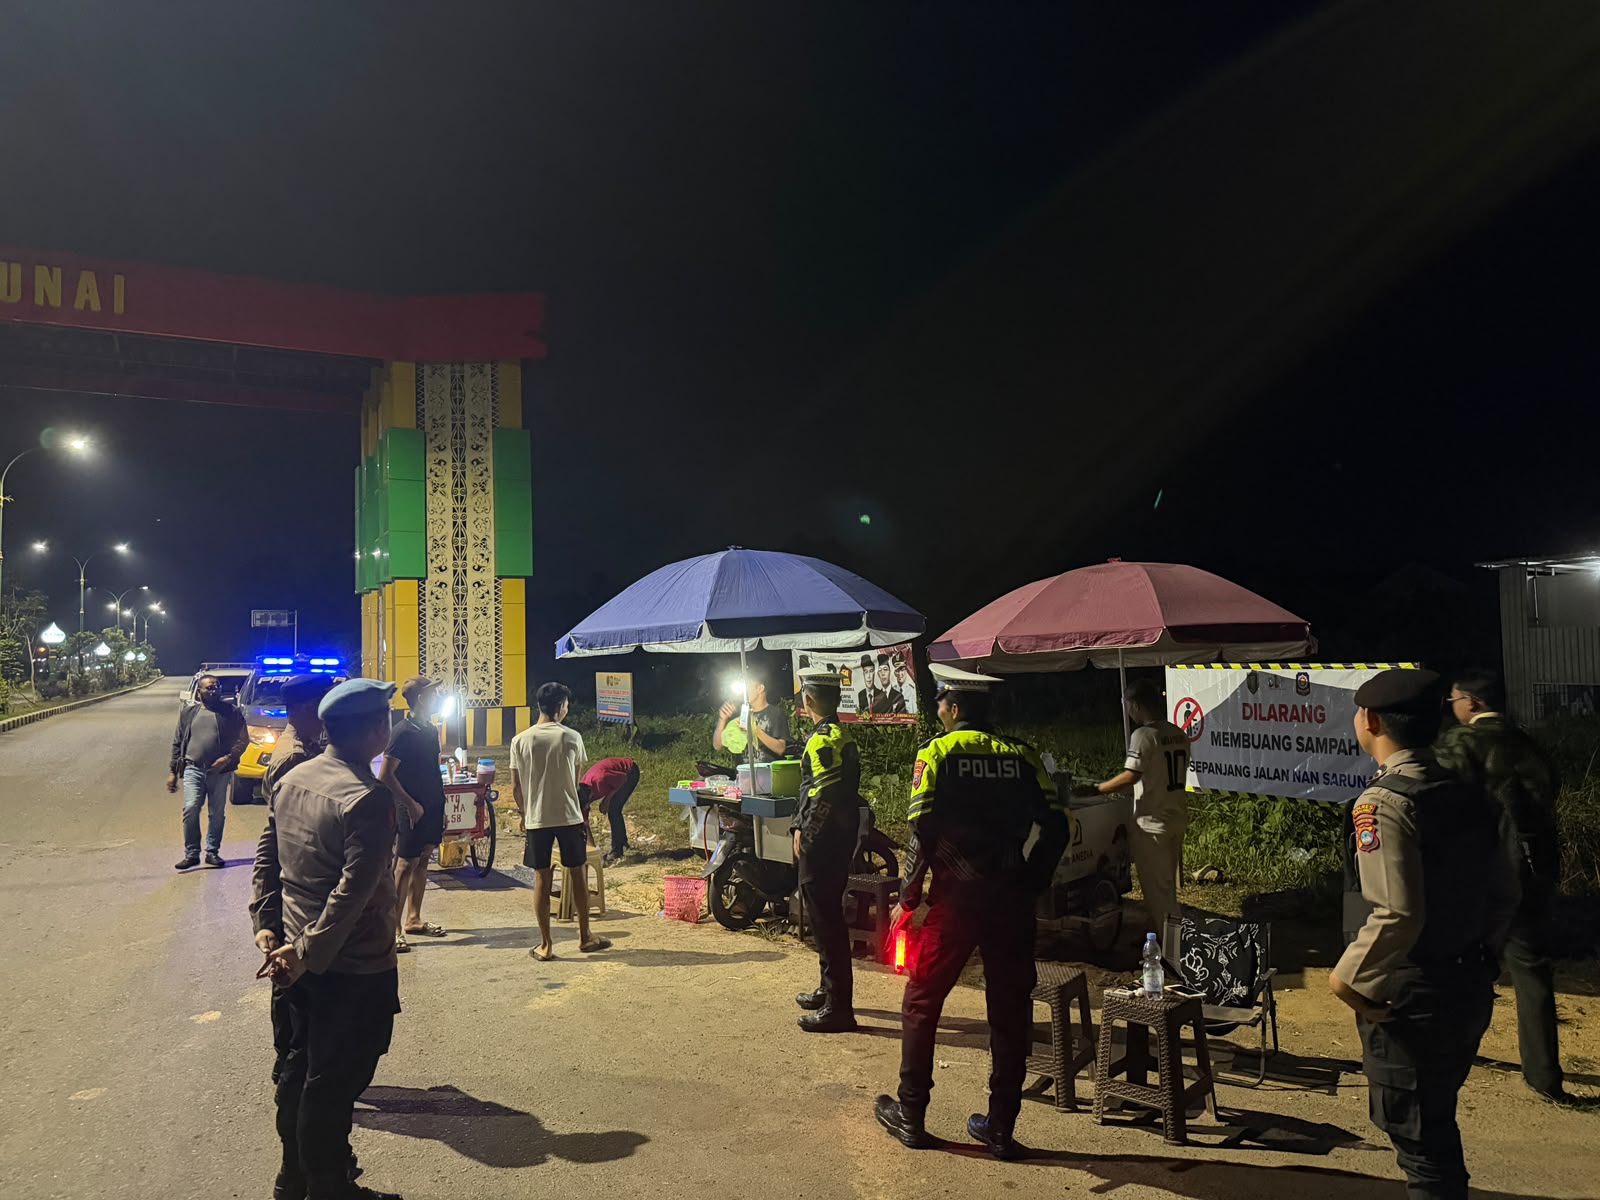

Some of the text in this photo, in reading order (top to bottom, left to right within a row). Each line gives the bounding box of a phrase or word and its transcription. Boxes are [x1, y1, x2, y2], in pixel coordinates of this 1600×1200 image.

[1242, 702, 1326, 724] DILARANG
[1211, 731, 1360, 756] MEMBUANG SAMPAH
[958, 758, 1021, 779] POLISI
[1189, 760, 1250, 778] SEPANJANG
[1253, 766, 1290, 782] JALAN
[1293, 770, 1320, 785] NAN
